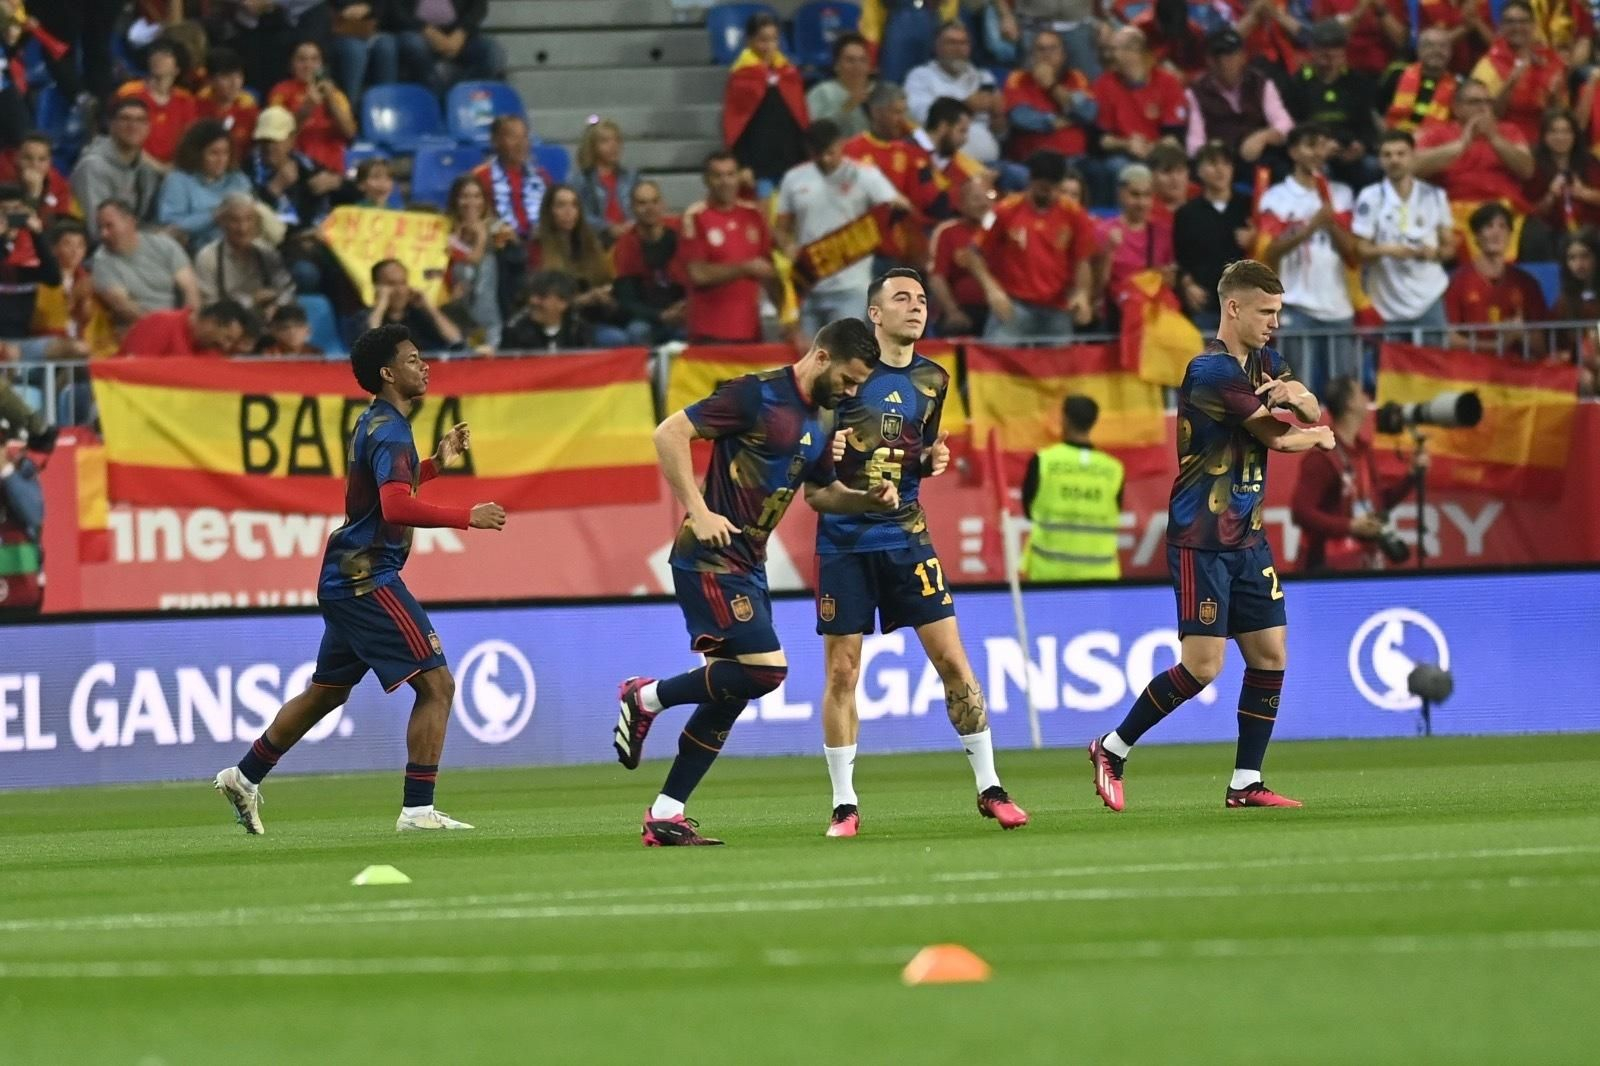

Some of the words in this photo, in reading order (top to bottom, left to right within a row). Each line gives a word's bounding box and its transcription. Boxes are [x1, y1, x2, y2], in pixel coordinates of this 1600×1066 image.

[238, 391, 476, 477] BAA
[913, 557, 945, 597] 17
[0, 671, 58, 752] EL
